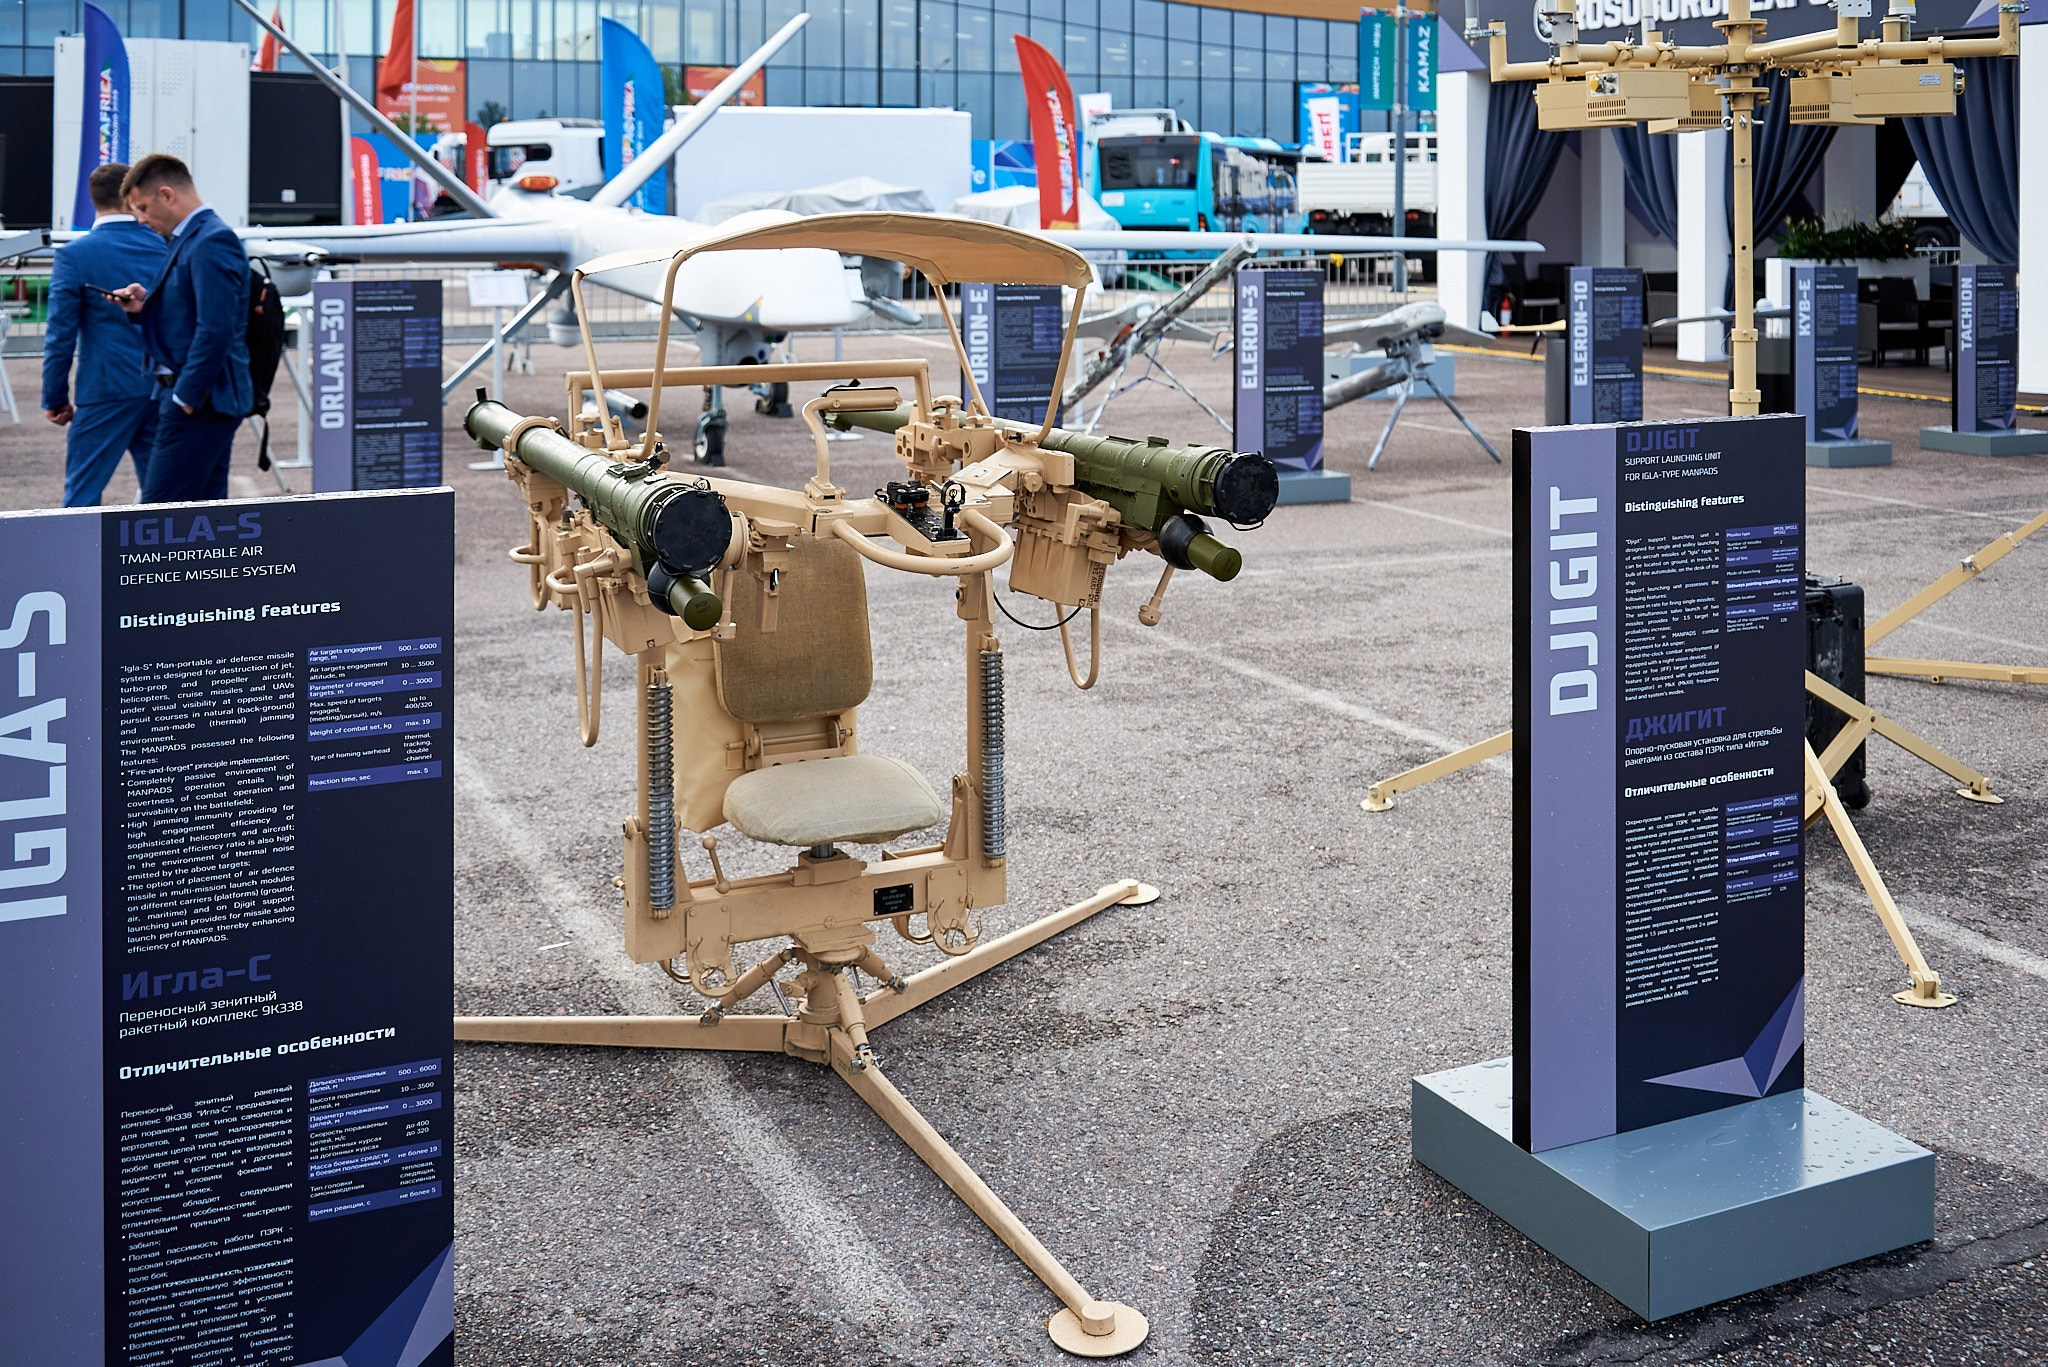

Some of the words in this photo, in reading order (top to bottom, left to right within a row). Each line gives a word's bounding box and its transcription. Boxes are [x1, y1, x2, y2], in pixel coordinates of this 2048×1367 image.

[1418, 26, 1431, 92] KAMAZ
[1799, 279, 1810, 336] KYB-E
[1962, 277, 1972, 351] TACHION
[970, 289, 988, 384] ORION-E
[1242, 284, 1258, 389] ELERON-3
[1574, 280, 1588, 386] ELERON-10
[320, 298, 345, 429] ORLAN-30
[1626, 428, 1700, 452] DJIGIT
[1625, 456, 1660, 466] SUPPORT
[1662, 452, 1703, 463] LAUNCHING
[1705, 451, 1722, 460] UNIT
[1625, 472, 1640, 481] FOR
[1642, 469, 1680, 480] IGLA-TYPE
[1682, 467, 1718, 477] MANPADS
[1625, 497, 1699, 513] Distinguishing
[120, 512, 263, 547] IGLA-S
[120, 546, 237, 565] TMAN-PORTABLE
[241, 544, 263, 557] AIR
[120, 571, 181, 586] DEFENCE
[185, 566, 239, 581] MISSILE
[242, 562, 296, 577] SYSTEM
[120, 607, 256, 628] Distinguishing
[1550, 486, 1598, 716] DJIGIT
[120, 673, 151, 684] system
[154, 671, 161, 679] is
[164, 668, 203, 679] designed
[205, 667, 217, 675] for
[220, 663, 268, 674] destruction
[270, 662, 279, 670] of
[156, 657, 213, 669] Man-portable
[216, 655, 227, 664] air
[230, 654, 264, 663] defence
[267, 650, 295, 660] missile
[120, 683, 168, 692] turbo-prop
[181, 678, 198, 687] and
[211, 675, 248, 687] propeller
[177, 689, 204, 698] cruise
[210, 685, 244, 695] missiles
[250, 683, 266, 692] and
[272, 681, 295, 690] UAVs
[1625, 706, 1727, 743] ДЖИГИТ
[1625, 740, 1692, 756] Опорно-пусковая
[1693, 735, 1731, 748] установка
[1732, 733, 1746, 742] для
[1748, 726, 1782, 739] стрельбы
[0, 590, 67, 922] IGLA-S
[1625, 754, 1662, 767] ракетами
[1674, 749, 1704, 758] состава
[1705, 744, 1725, 754] ПЗРК
[1726, 743, 1743, 751] типа
[1745, 738, 1769, 749] «Игла»
[1625, 778, 1707, 797] Отличительные
[1710, 768, 1774, 784] особенности
[122, 953, 272, 1000] Игла-С
[120, 1000, 206, 1023] Переносный
[210, 990, 277, 1009] зенитный
[120, 1015, 187, 1038] ракетный
[192, 1008, 258, 1025] комплекс
[262, 999, 303, 1015] 9К338
[120, 1047, 272, 1079] Отличительные
[278, 1027, 395, 1054] особенности
